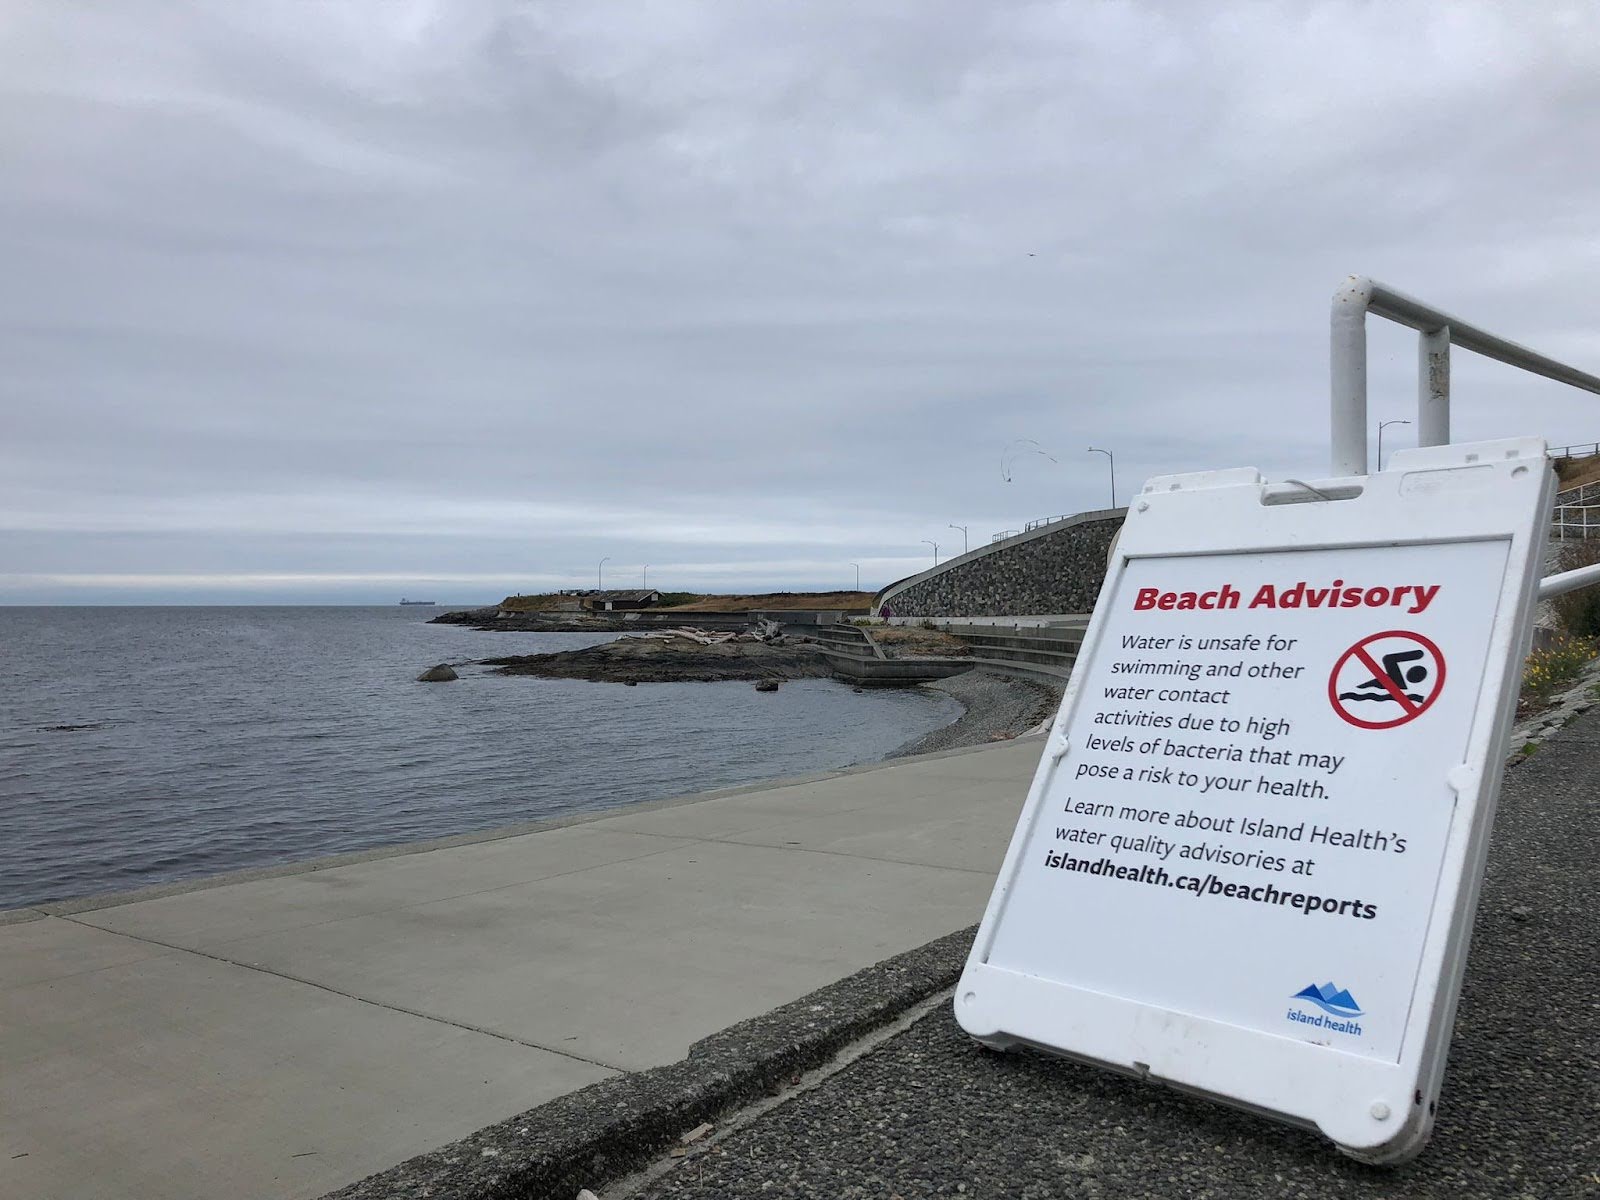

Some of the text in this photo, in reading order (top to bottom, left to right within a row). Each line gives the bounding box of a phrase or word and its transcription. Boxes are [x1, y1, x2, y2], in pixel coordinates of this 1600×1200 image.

[1133, 579, 1441, 614] Beach Advisory
[1122, 633, 1298, 651] Water is unsafe for
[1111, 659, 1305, 681] swimming and other
[1105, 686, 1231, 704] water contact
[1094, 710, 1290, 740] activities due to high
[1086, 733, 1345, 774] levels of bacteria that may
[1075, 764, 1329, 799] pose a risk to your health.
[1064, 797, 1114, 818] Learn
[1119, 807, 1170, 825] more
[1174, 810, 1235, 833] about
[1240, 818, 1305, 841] Island
[1056, 827, 1315, 876] water quality advisories at
[1045, 850, 1378, 919] islandhealth.ca/beachreports
[1287, 1008, 1362, 1036] island health
